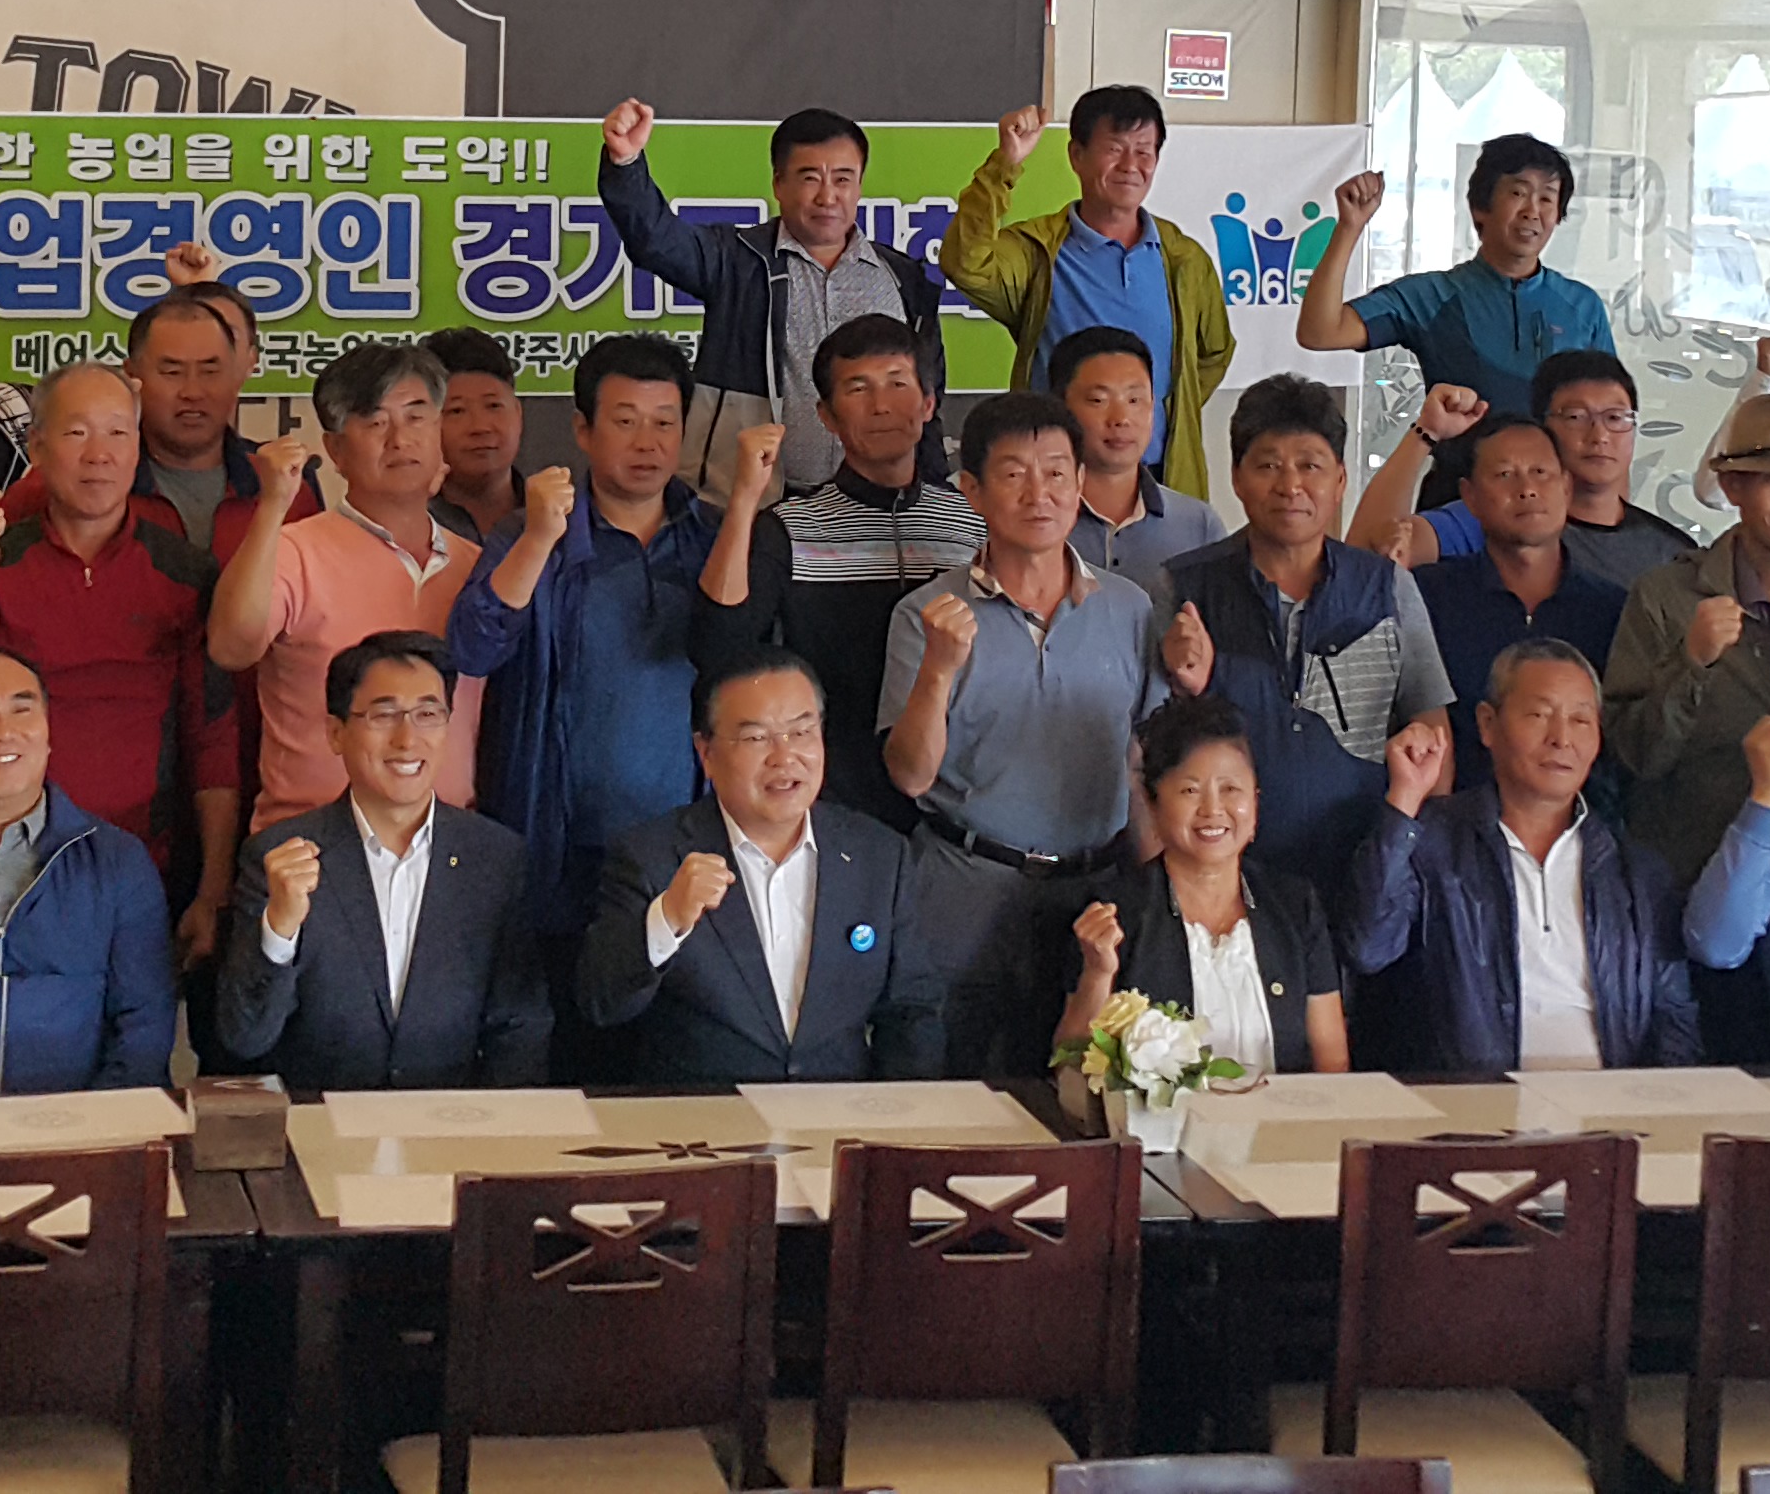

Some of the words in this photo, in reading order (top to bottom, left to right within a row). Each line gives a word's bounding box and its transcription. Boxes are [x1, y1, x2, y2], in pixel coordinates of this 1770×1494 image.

[66, 132, 233, 182] 농업을
[263, 133, 371, 183] 위한
[400, 136, 550, 186] 도약!!
[1228, 267, 1315, 306] 365
